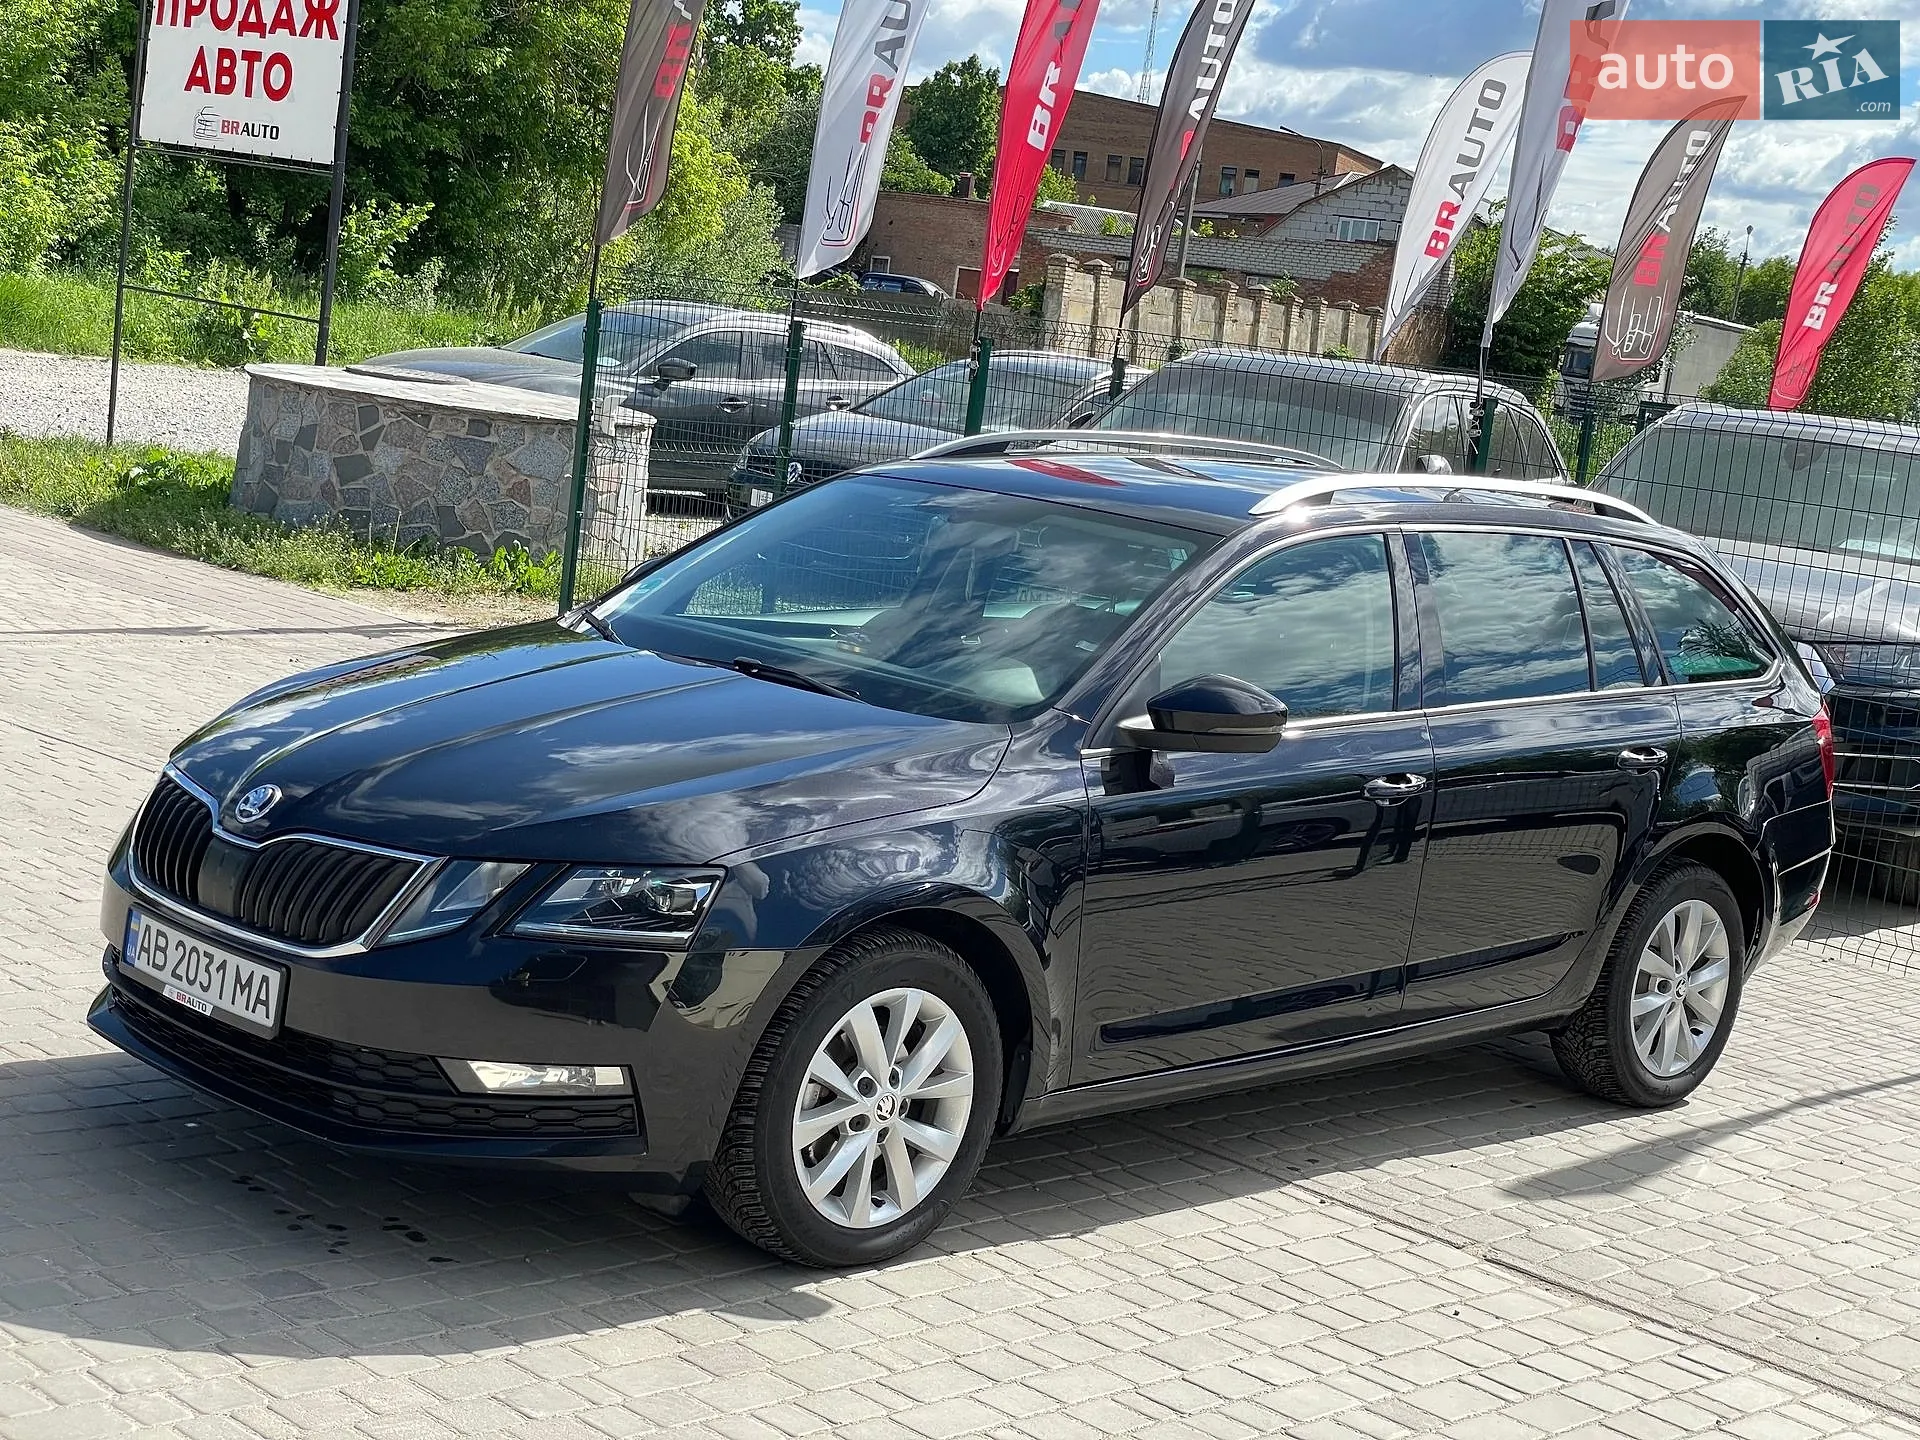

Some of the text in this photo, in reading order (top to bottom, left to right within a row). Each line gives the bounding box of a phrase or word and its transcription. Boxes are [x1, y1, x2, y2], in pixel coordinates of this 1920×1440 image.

[155, 0, 341, 41] ПРОДАЖ
[184, 46, 293, 102] АВТО
[220, 119, 280, 141] BRAUTO
[1424, 78, 1507, 259] BRAUTO
[127, 944, 136, 958] UA
[137, 924, 271, 1019] AB 2031 MA
[176, 991, 207, 1012] BRAUTO
